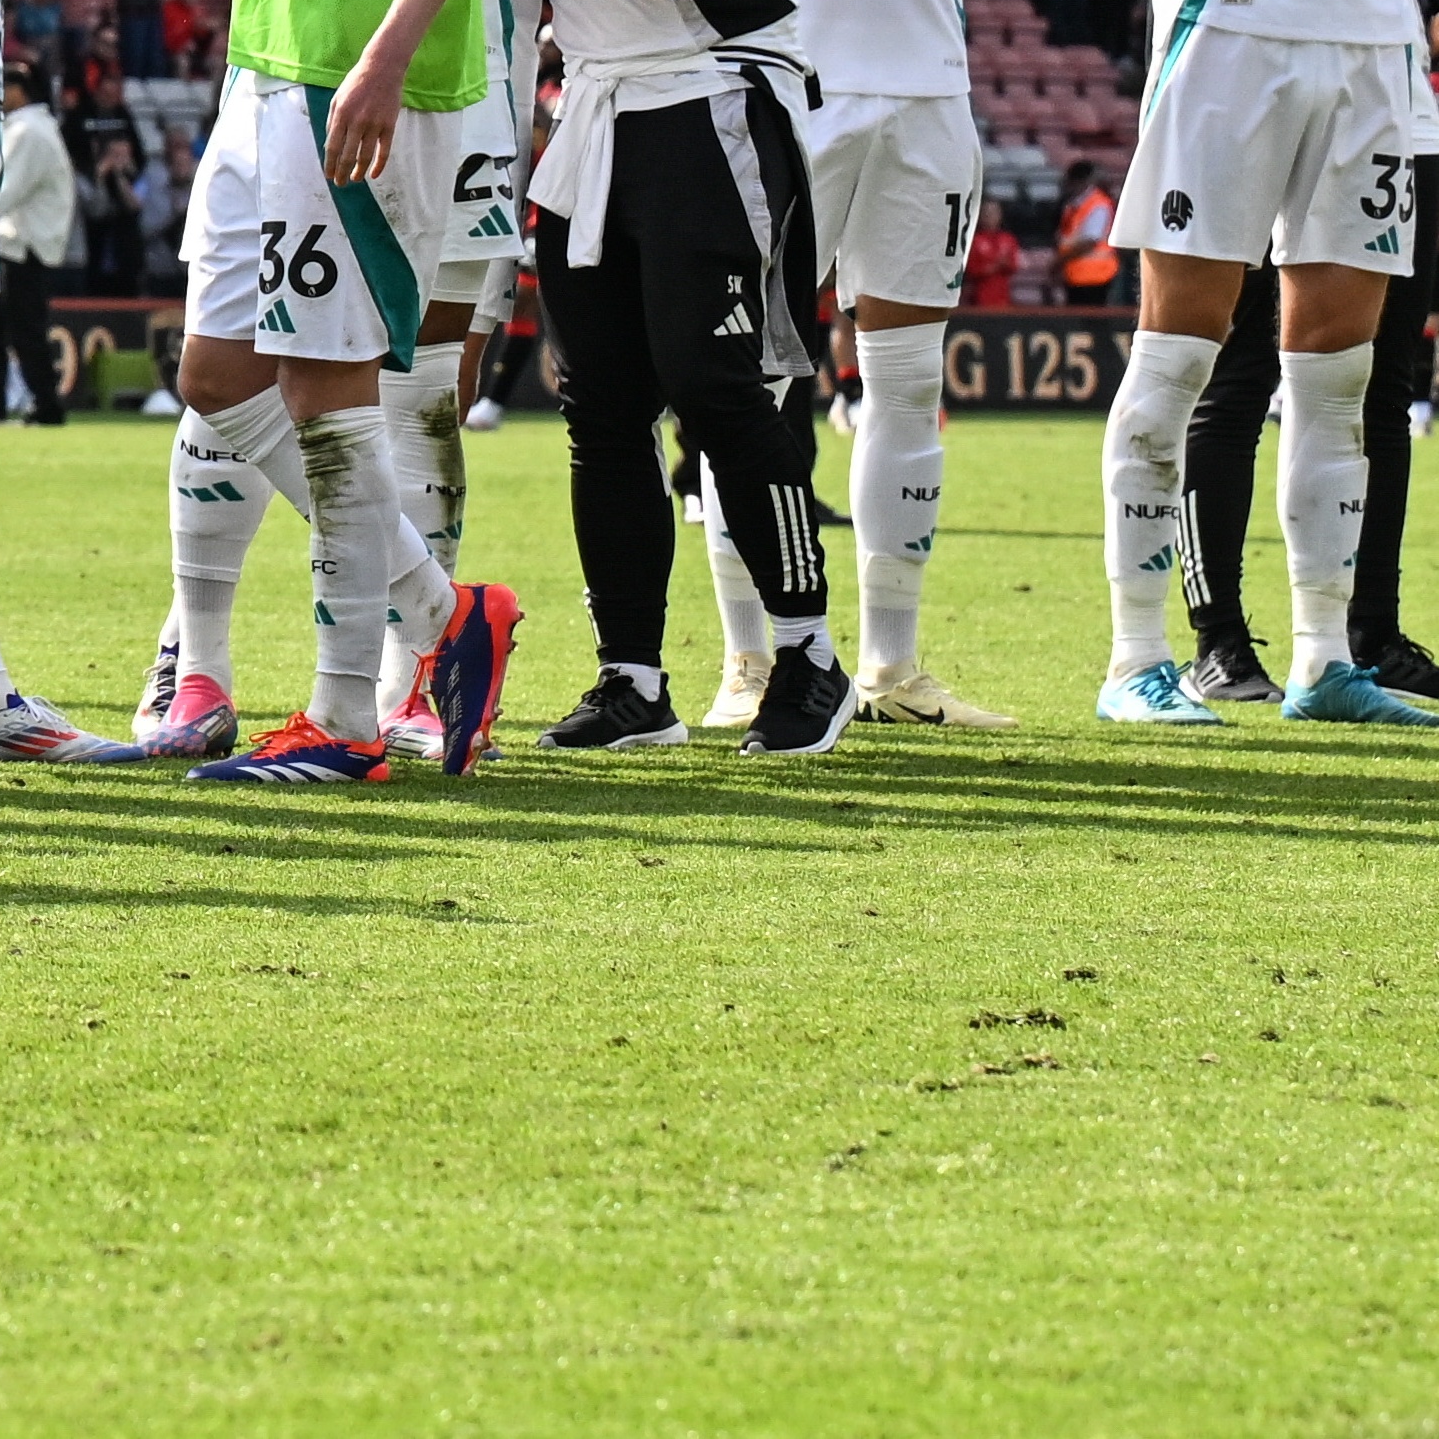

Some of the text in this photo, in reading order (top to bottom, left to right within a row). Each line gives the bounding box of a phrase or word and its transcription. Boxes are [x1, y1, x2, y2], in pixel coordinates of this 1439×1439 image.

[1360, 153, 1414, 223] 33
[259, 220, 338, 299] 36
[1006, 331, 1099, 400] 125
